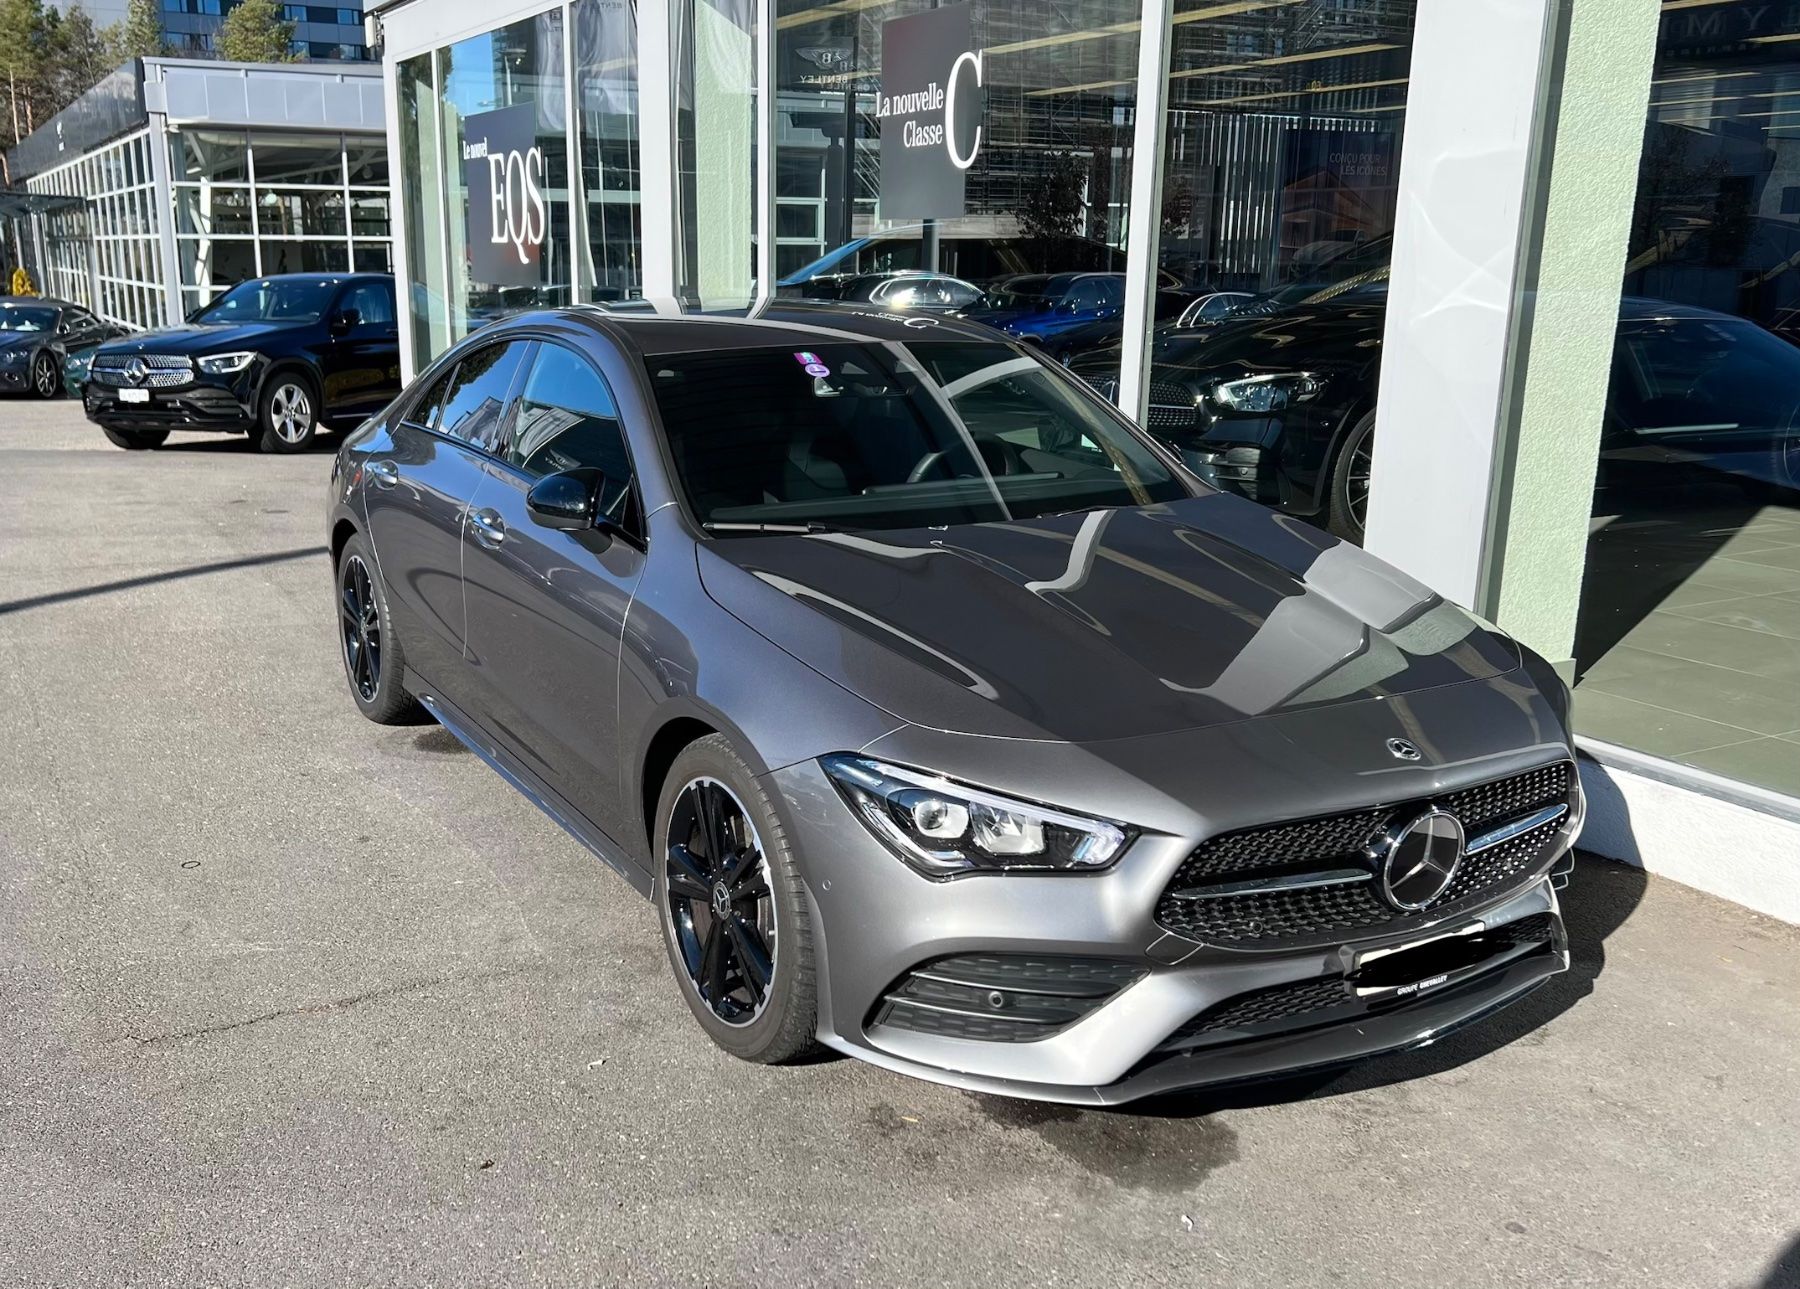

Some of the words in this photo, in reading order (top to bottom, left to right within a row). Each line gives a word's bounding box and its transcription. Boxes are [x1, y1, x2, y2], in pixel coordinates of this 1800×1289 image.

[876, 92, 890, 117] La
[893, 82, 944, 115] nouvelle
[903, 120, 943, 148] Classe
[945, 49, 982, 169] C
[487, 146, 545, 265] EQS
